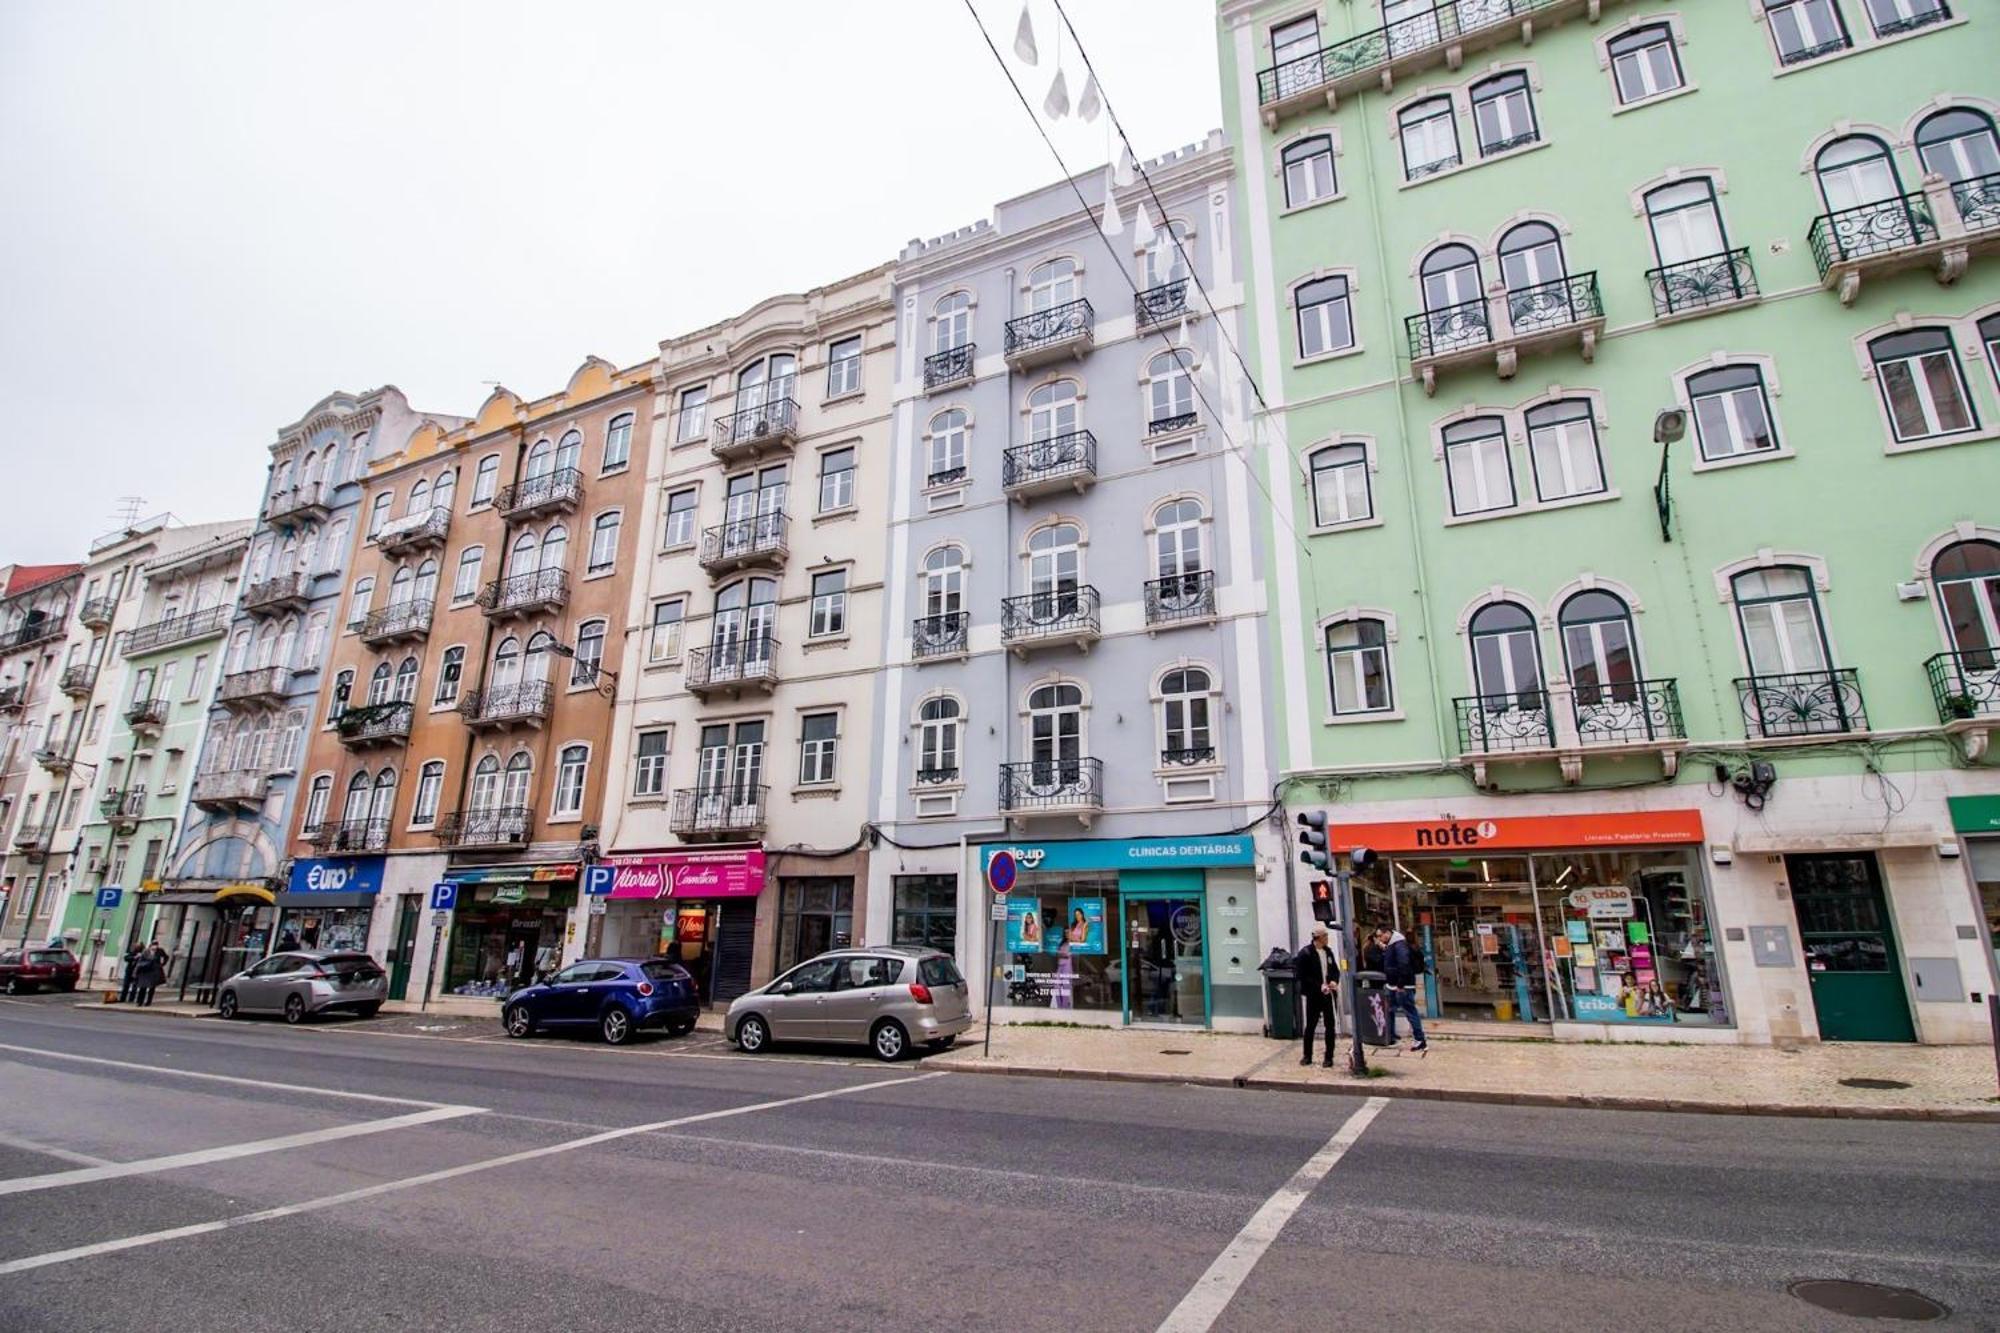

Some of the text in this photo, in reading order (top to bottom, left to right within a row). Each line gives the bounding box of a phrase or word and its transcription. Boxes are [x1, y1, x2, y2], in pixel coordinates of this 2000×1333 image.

[590, 868, 609, 892] P
[101, 890, 116, 905] P
[436, 886, 452, 907] P
[1579, 998, 1618, 1010] tribo
